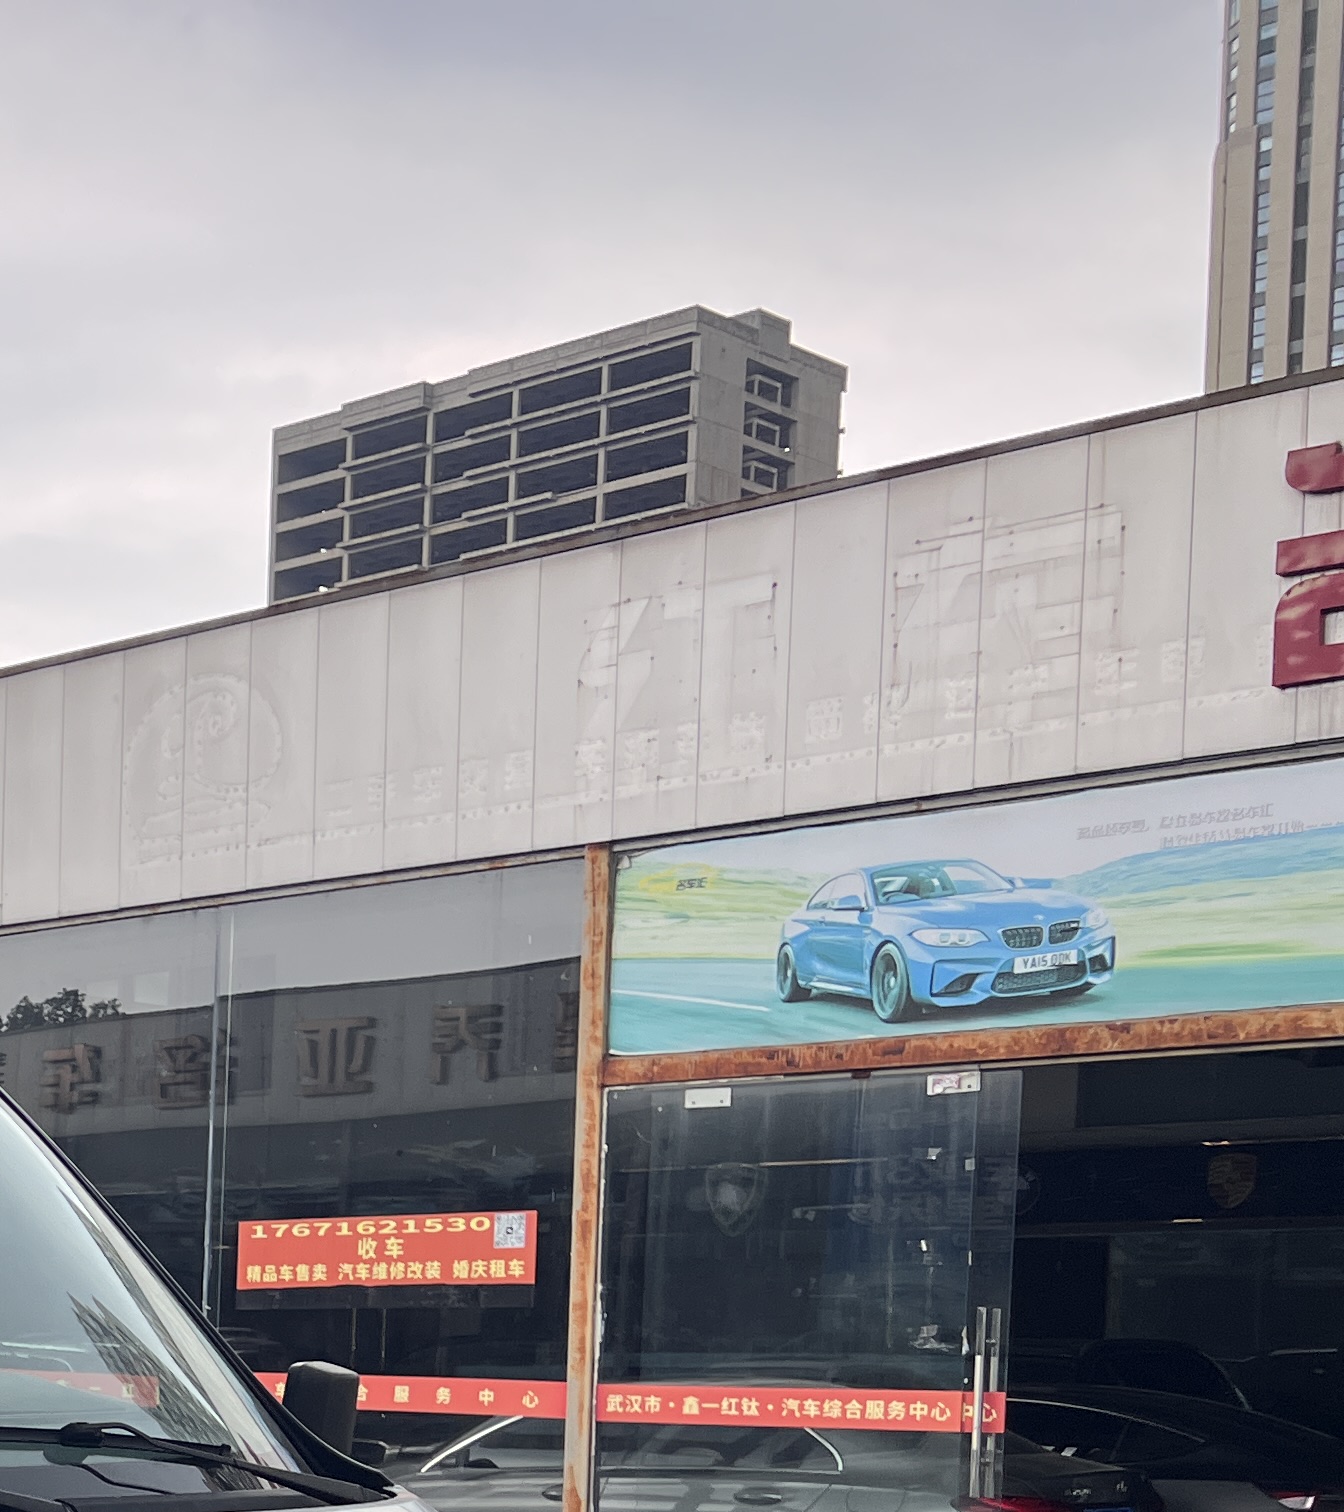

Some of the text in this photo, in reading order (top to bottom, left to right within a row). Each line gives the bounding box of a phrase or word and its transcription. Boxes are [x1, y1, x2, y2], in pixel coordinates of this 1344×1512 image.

[250, 1216, 491, 1239] 17671621530
[358, 1237, 404, 1260] 收车
[246, 1258, 525, 1283] 精品车售卖 汽车维修改装 婚庆租车
